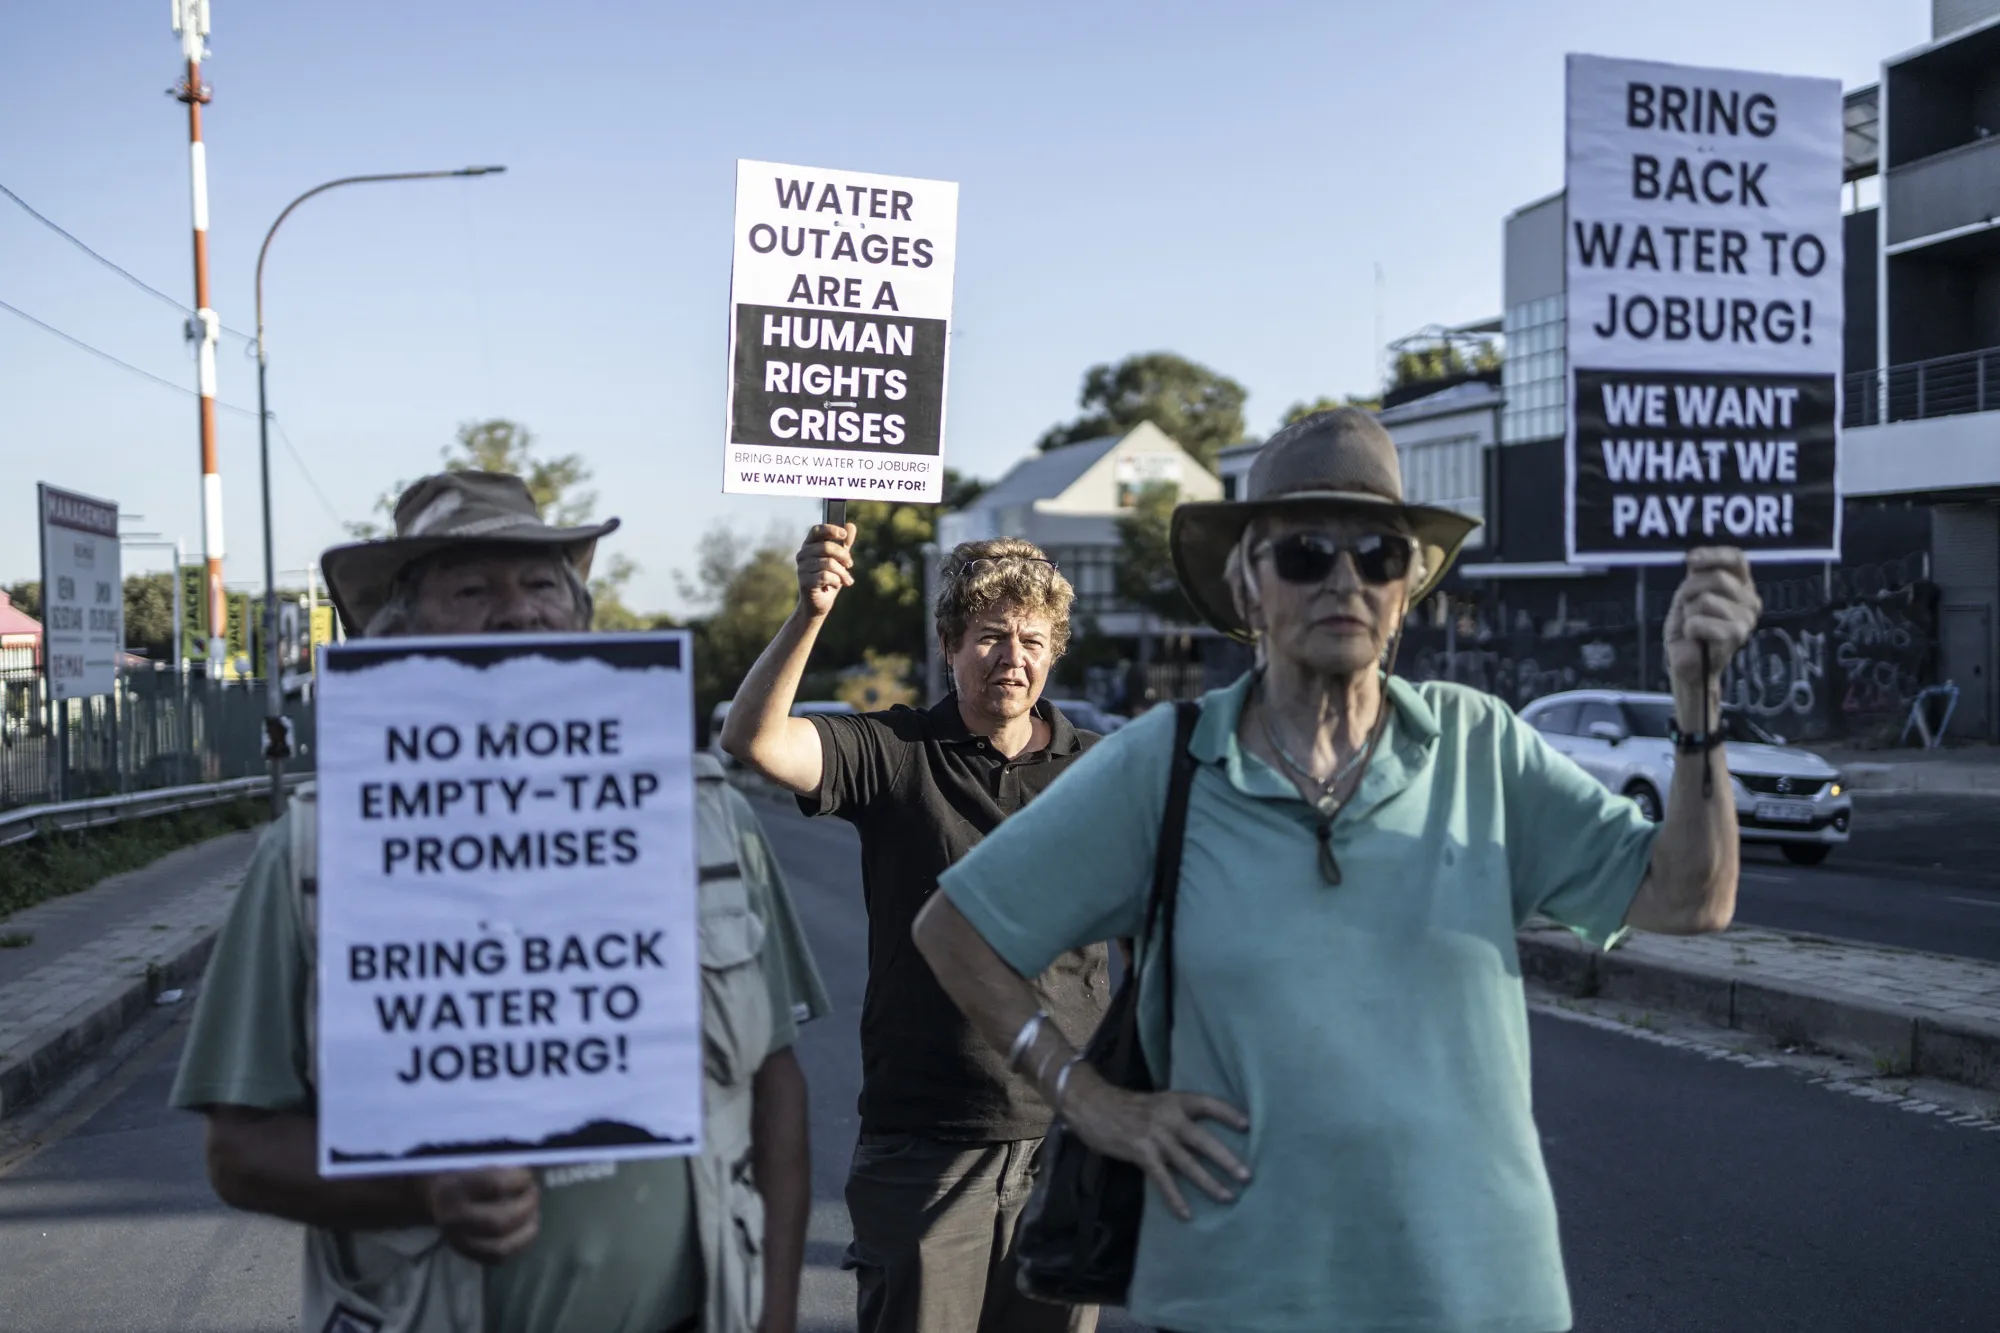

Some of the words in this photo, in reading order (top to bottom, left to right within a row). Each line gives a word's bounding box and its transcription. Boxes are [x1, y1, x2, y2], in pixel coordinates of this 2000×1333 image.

[1625, 81, 1777, 139] BRING
[774, 177, 914, 222] WATER
[1632, 153, 1769, 208] BACK
[748, 223, 934, 269] OUTAGES
[1573, 220, 1748, 275] WATER
[1761, 231, 1827, 278] TO
[786, 273, 863, 309] ARE
[871, 280, 900, 312] A
[762, 313, 914, 357] HUMAN
[1593, 293, 1813, 346] JOBURG!
[764, 360, 908, 401] RIGHTS
[769, 406, 906, 446] CRISES
[1601, 383, 1667, 427] WE
[1673, 385, 1799, 428] WANT
[734, 451, 772, 465] BRING
[775, 454, 809, 467] BACK
[812, 456, 854, 469] WATER
[858, 459, 874, 470] TO
[876, 460, 930, 473] JOBURG!
[740, 471, 760, 483] WE
[763, 472, 803, 485] WANT
[806, 474, 845, 487] WHAT
[847, 476, 867, 488] WE
[869, 478, 894, 490] PAY
[897, 480, 926, 492] FOR!
[1601, 439, 1728, 482] WHAT
[1734, 440, 1798, 481] WE
[1613, 494, 1695, 538] PAY
[1702, 493, 1794, 536] FOR!
[386, 724, 462, 763] NO
[477, 719, 620, 759] MORE
[360, 772, 659, 820] EMPTY-TAP
[383, 828, 639, 875] PROMISES
[349, 938, 507, 982] BRING
[523, 931, 665, 974] BACK
[375, 988, 558, 1033] WATER
[573, 984, 640, 1022] TO
[397, 1034, 628, 1085] JOBURG!
